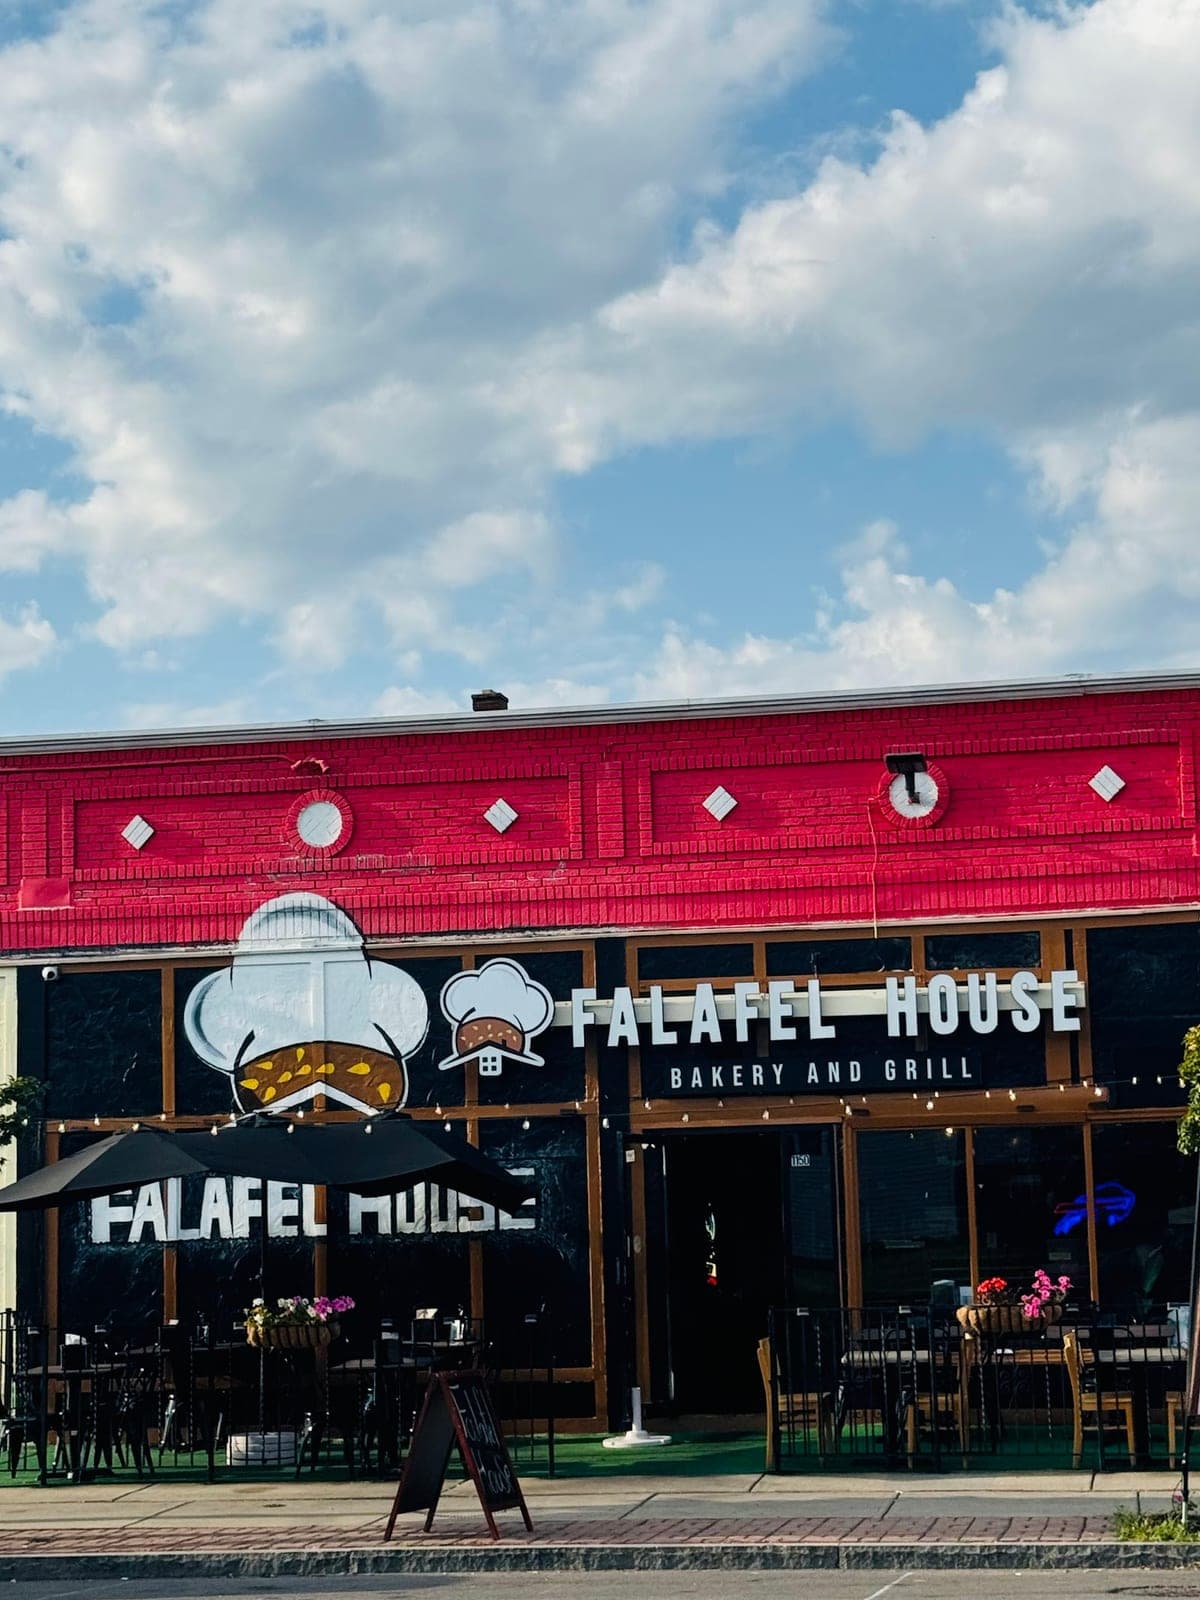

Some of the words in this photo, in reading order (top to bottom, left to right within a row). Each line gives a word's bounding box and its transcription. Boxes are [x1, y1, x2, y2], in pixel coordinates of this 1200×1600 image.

[571, 979, 836, 1048] FALAFEL
[885, 970, 1081, 1037] HOUSE
[670, 1063, 784, 1089] BAKERY
[807, 1061, 862, 1084] AND
[885, 1057, 973, 1081] GRILL
[91, 1175, 328, 1244] FALAFEL
